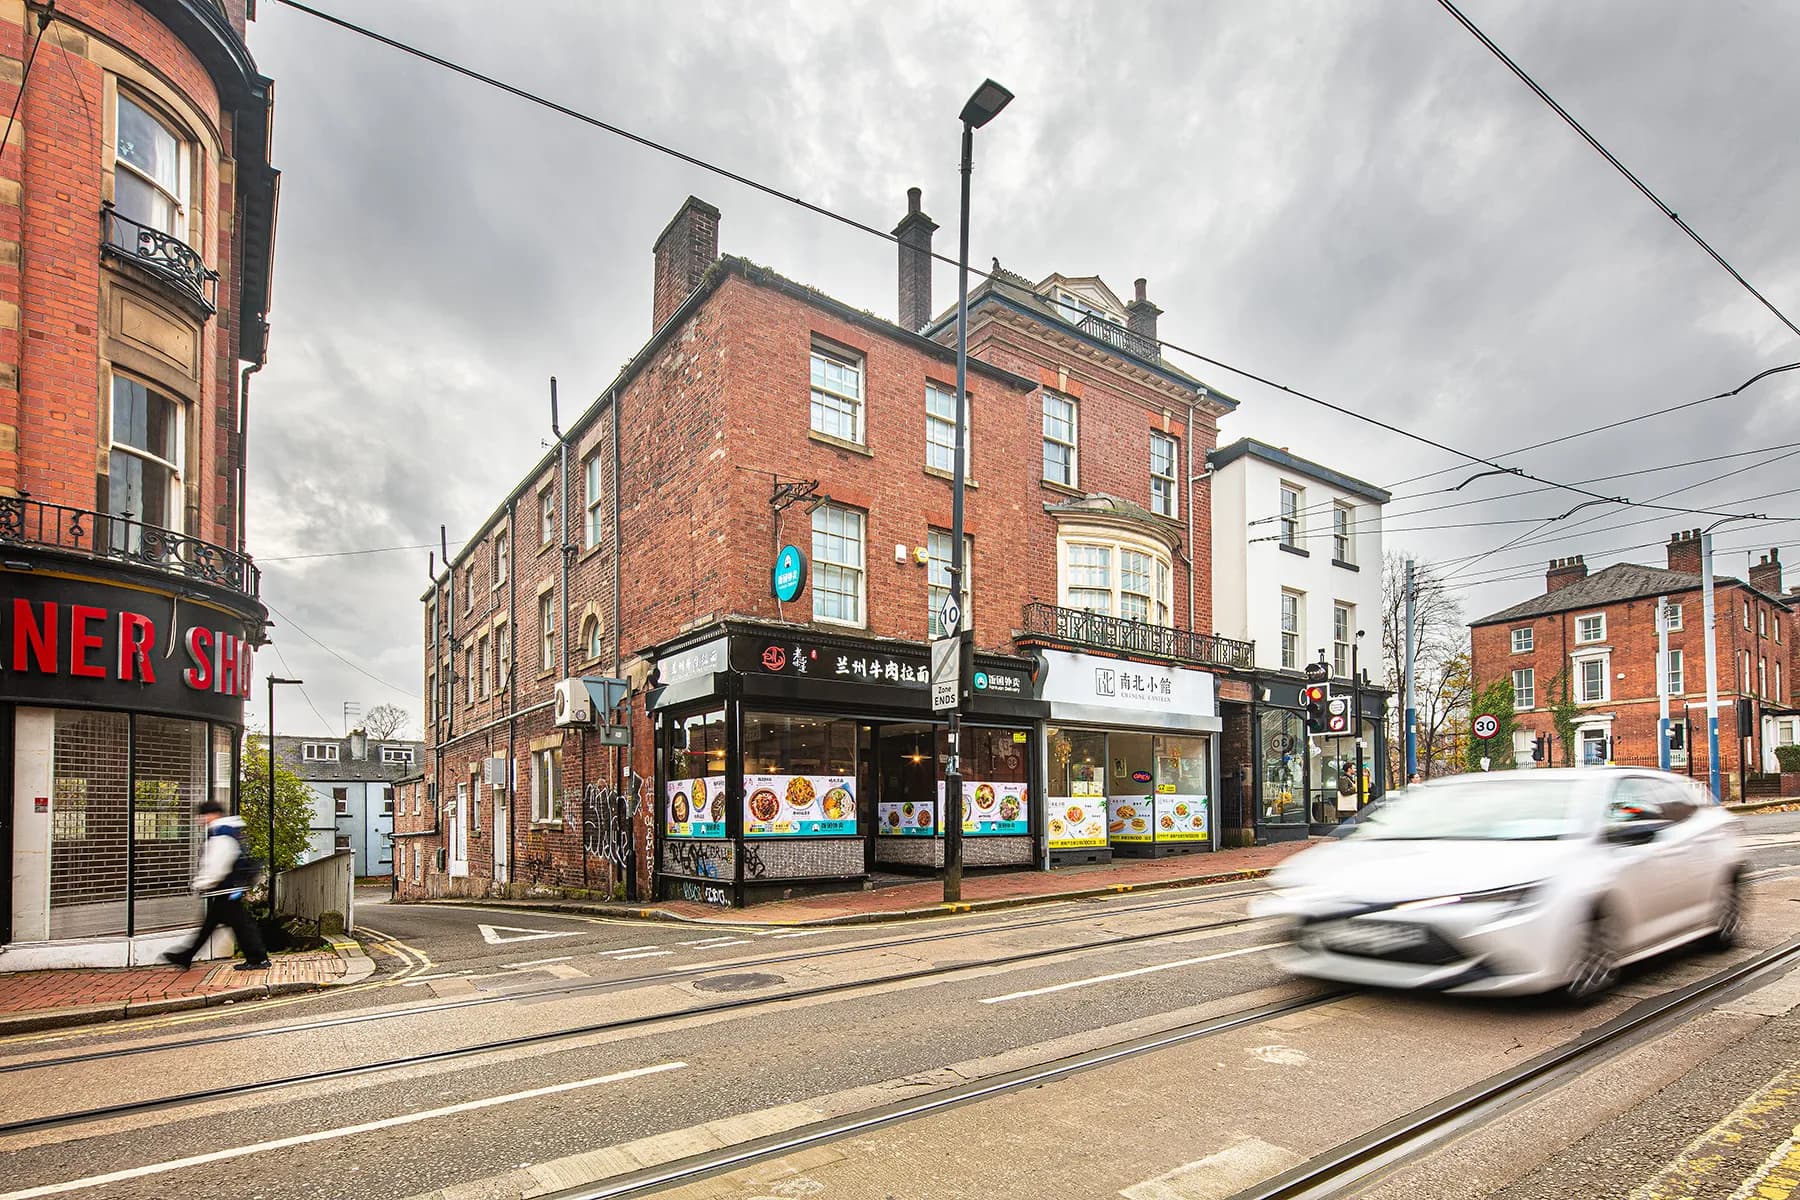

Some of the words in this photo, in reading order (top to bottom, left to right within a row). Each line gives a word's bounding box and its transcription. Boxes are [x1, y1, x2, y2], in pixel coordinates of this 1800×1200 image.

[943, 607, 958, 625] 10
[0, 598, 156, 683] NER
[836, 656, 930, 684] 兰州牛肉拉面
[938, 686, 952, 695] Zone
[934, 694, 956, 706] ENDS
[1476, 721, 1496, 732] 30
